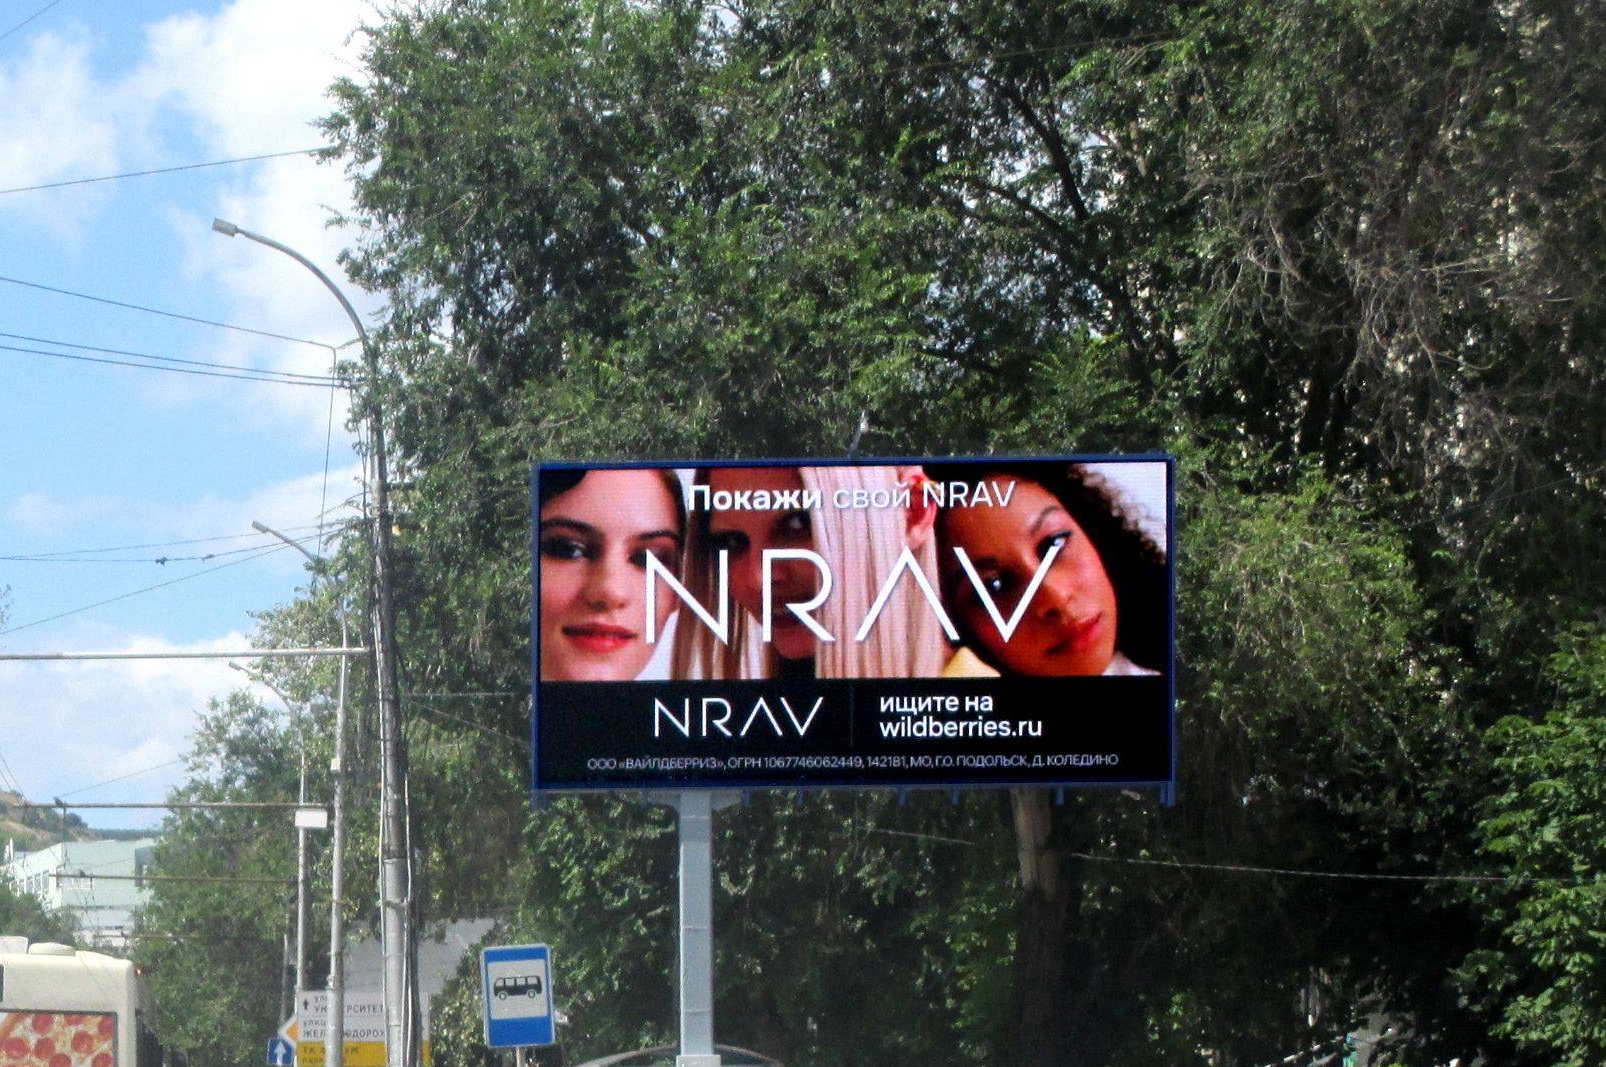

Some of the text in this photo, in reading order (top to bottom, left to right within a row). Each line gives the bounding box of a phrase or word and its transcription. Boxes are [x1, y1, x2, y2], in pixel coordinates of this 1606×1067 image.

[688, 481, 1016, 511] Покажи свой NRAV
[644, 546, 1062, 646] NRAV
[653, 696, 824, 738] NRAV
[879, 695, 994, 715] ищите на
[879, 714, 1043, 738] wildberries.ru
[587, 758, 617, 770] ООО
[727, 757, 762, 769] ОГРН
[956, 754, 1030, 769] ПОДОЛЬСК,
[1046, 753, 1119, 767] КОЛЕДИНО
